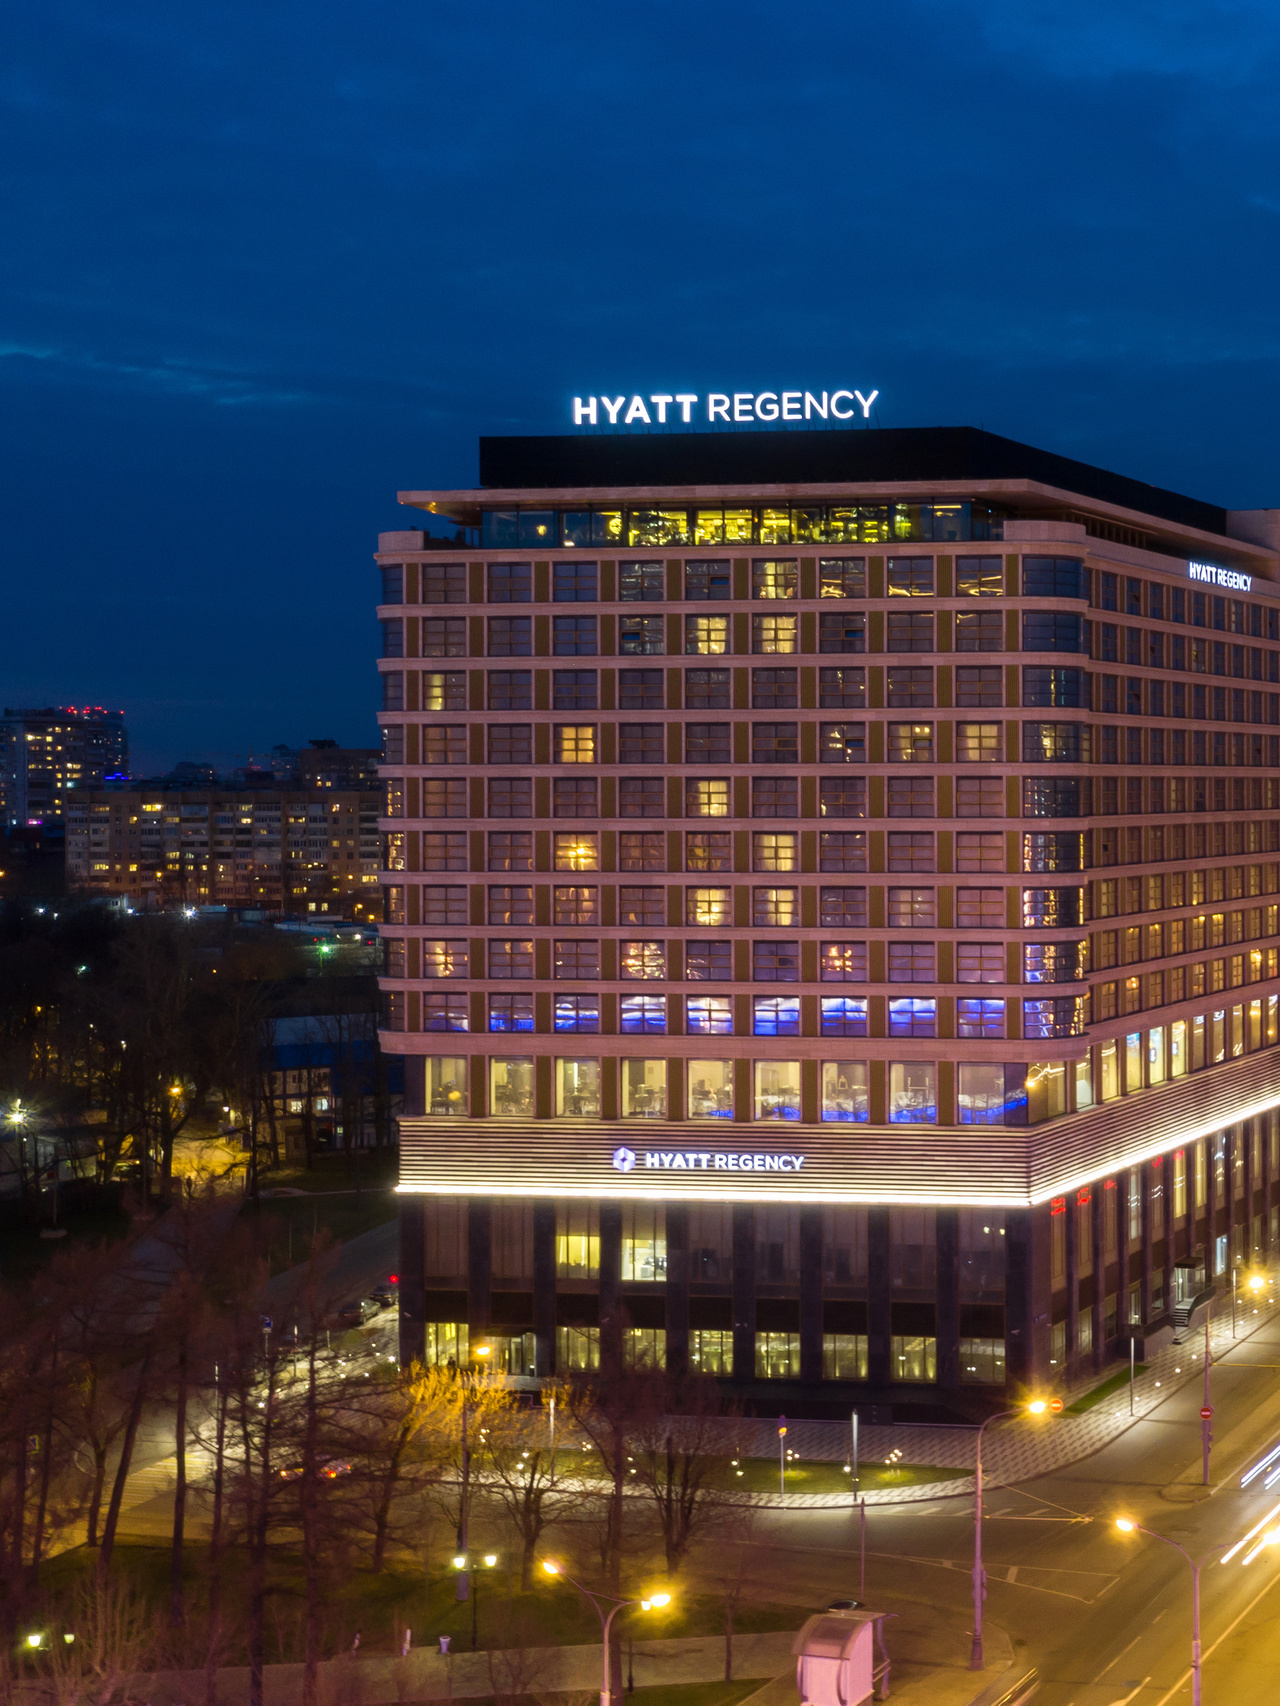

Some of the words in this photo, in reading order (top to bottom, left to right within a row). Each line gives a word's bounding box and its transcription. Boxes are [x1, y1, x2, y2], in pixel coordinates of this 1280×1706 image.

[573, 394, 699, 425] HYATT
[708, 390, 879, 422] REGENCY
[1189, 561, 1217, 584] HYATT
[1217, 568, 1252, 592] REGENCY
[645, 1153, 711, 1170] HYATT
[714, 1154, 805, 1172] REGENCY
